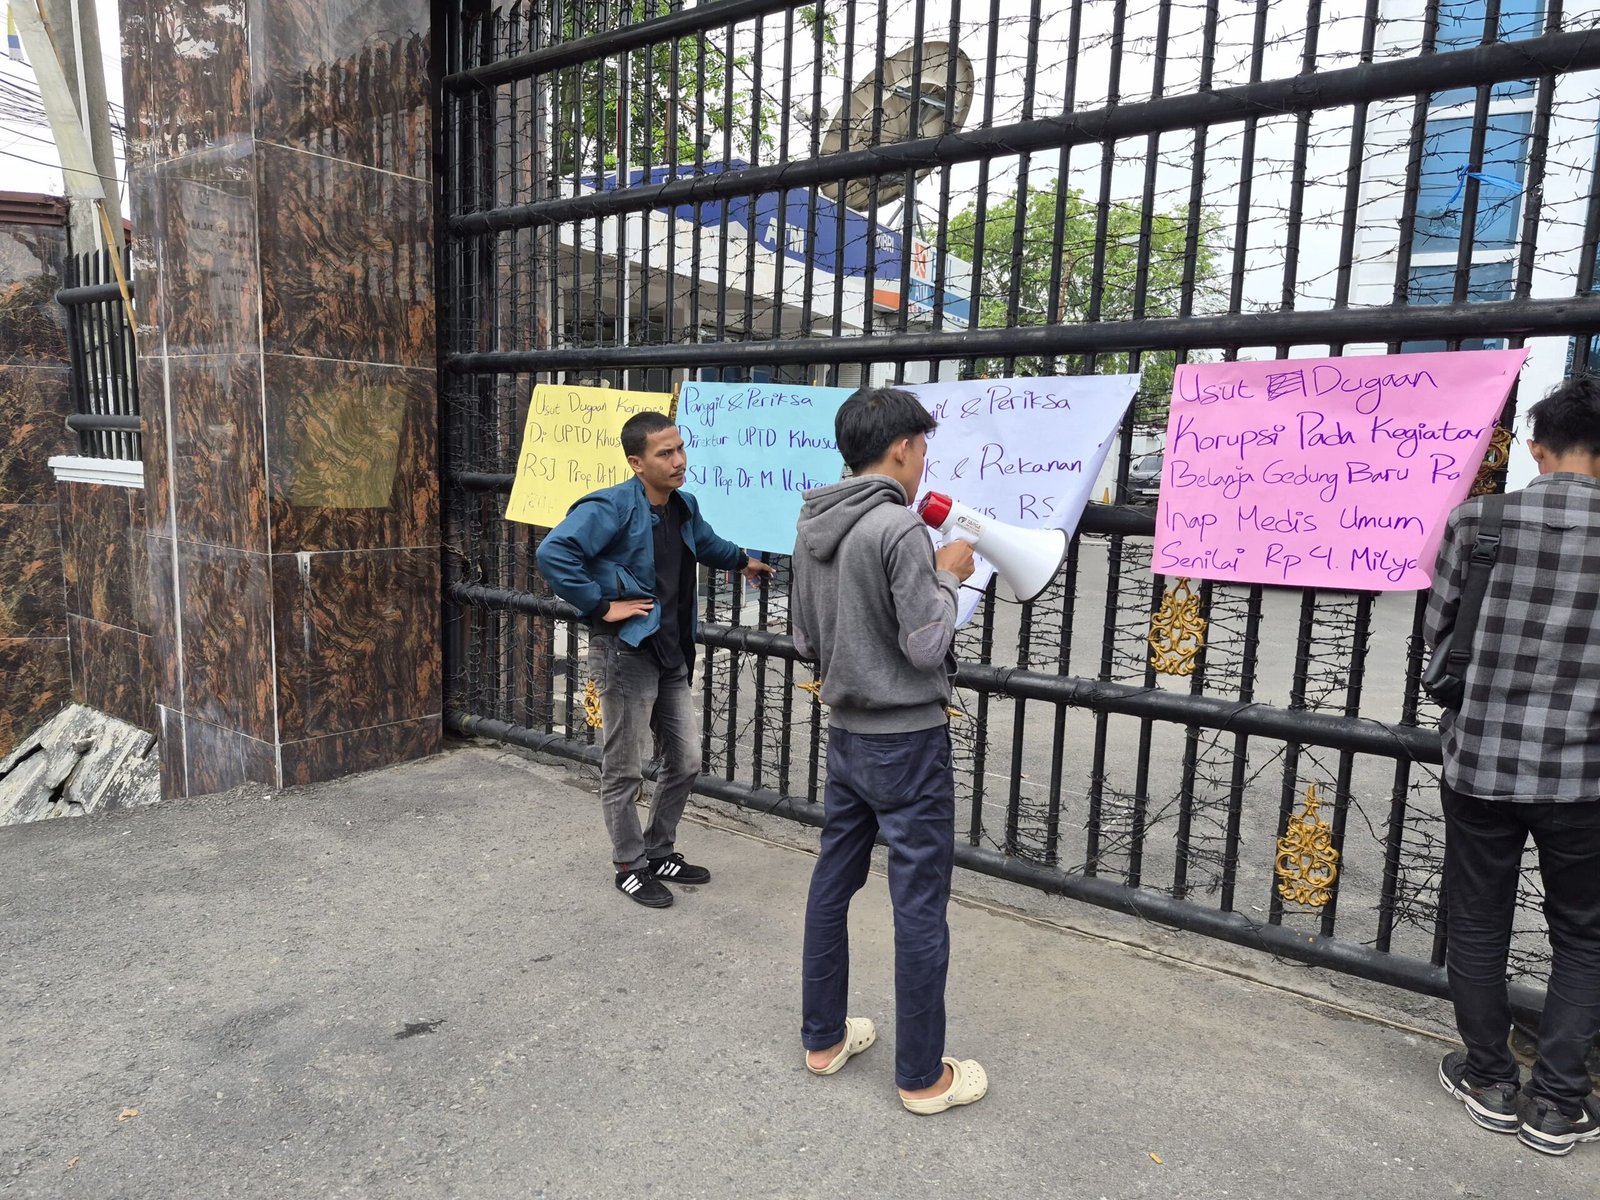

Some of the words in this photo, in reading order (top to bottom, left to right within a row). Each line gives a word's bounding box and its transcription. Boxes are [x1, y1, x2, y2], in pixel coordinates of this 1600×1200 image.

[727, 392, 744, 413] &
[746, 387, 814, 410] Periksa
[960, 397, 982, 419] &
[986, 385, 1071, 414] Periksa
[1178, 370, 1255, 405] Usut
[1312, 364, 1439, 415] Dugaan
[535, 391, 561, 416] Usut
[567, 392, 607, 424] Dugaan
[553, 423, 592, 444] UPTD
[595, 430, 622, 449] Khus
[737, 425, 778, 449] UPTD
[788, 430, 841, 452] Khusu
[1173, 414, 1286, 461] Korupsi
[1296, 411, 1356, 450] Pada
[523, 452, 556, 482] RSJ
[683, 464, 707, 485] SJ
[760, 470, 774, 489] M
[950, 456, 970, 481] &
[980, 442, 1083, 481] Rekanan
[1170, 459, 1255, 500] Belanja
[1262, 459, 1338, 503] Gedung
[1346, 461, 1410, 485] Baru
[1019, 493, 1056, 520] RS
[1165, 501, 1218, 542] Inap
[1238, 504, 1318, 534] Medis
[1339, 505, 1424, 536] Umum
[1161, 540, 1246, 572] Senilai
[1265, 542, 1302, 580] Rp
